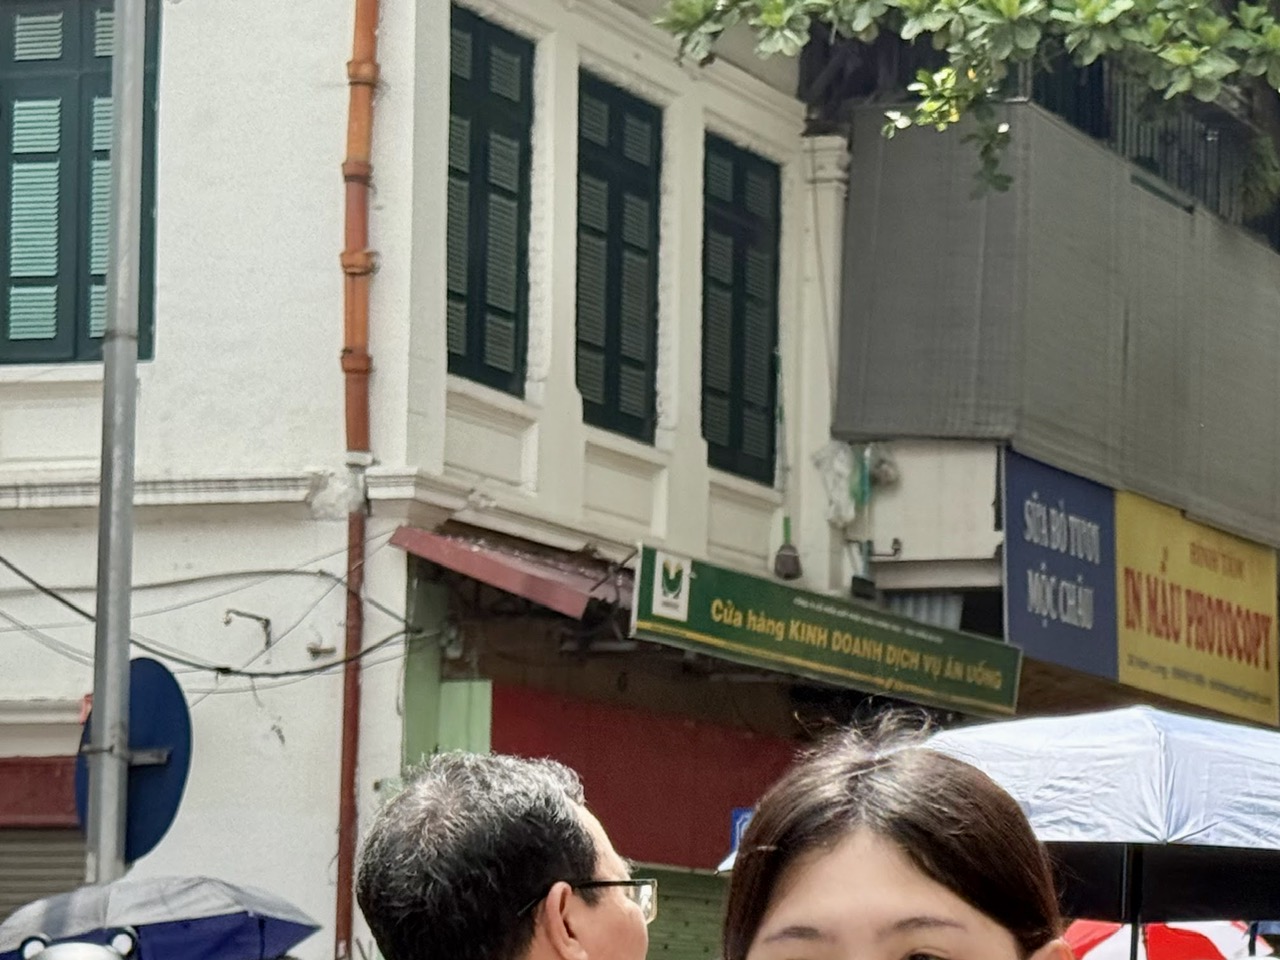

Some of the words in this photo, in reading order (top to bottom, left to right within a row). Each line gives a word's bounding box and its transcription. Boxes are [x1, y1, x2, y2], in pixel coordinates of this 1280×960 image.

[1027, 561, 1057, 629] MỘC
[1059, 574, 1094, 630] CHÂU
[1124, 566, 1143, 630] IN
[710, 597, 743, 628] Cửa
[746, 608, 786, 643] hàng
[788, 619, 829, 650] KINH
[831, 628, 883, 663] DOANH
[886, 644, 920, 672] DỊCH
[922, 654, 944, 682] VỤ
[945, 656, 965, 680] ĂN
[966, 660, 1003, 691] UỐNG
